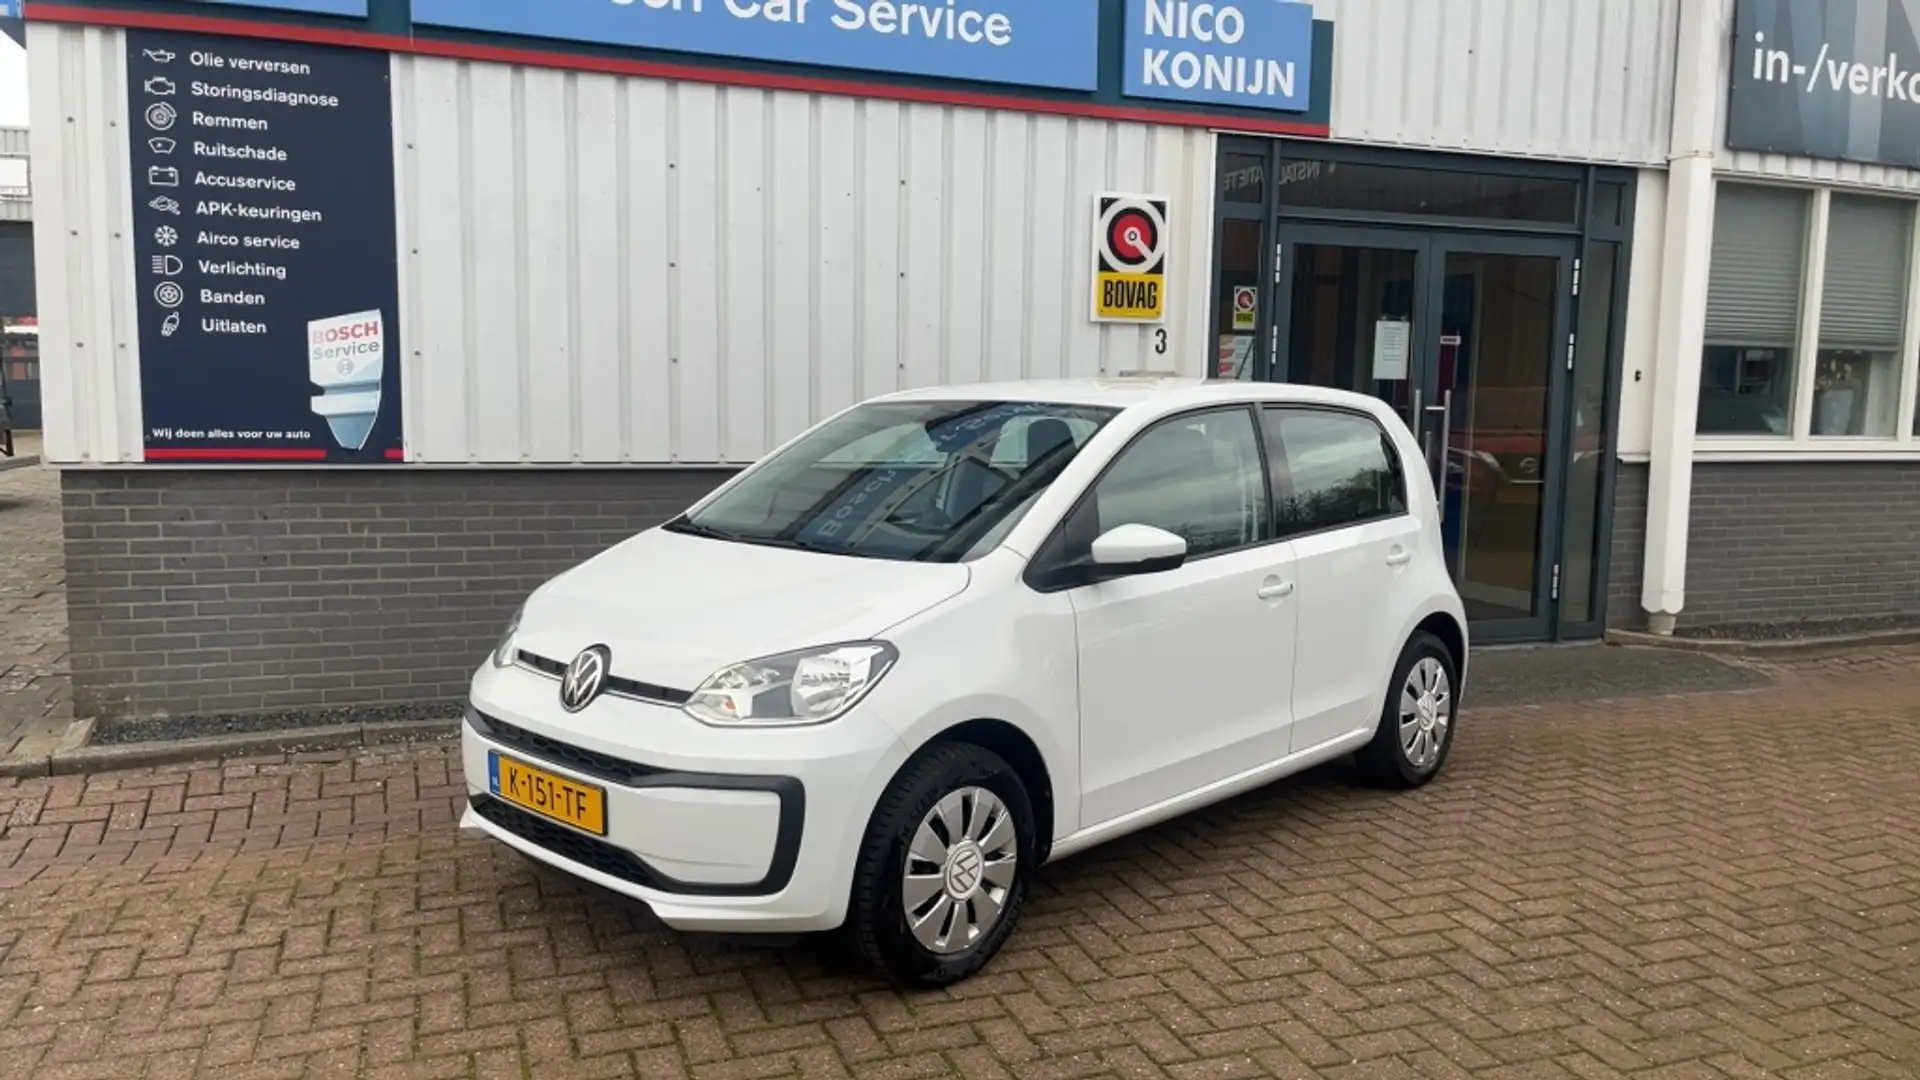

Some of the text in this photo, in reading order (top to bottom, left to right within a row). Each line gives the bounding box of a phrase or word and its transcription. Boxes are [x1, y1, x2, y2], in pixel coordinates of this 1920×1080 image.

[830, 0, 1012, 46] Service
[1144, 0, 1245, 44] NICO
[190, 51, 310, 75] Olie verversen
[1143, 48, 1295, 97] KONIJN
[191, 81, 339, 107] Storingsdiagnose
[192, 111, 268, 130] Remmen
[193, 141, 288, 161] Ruitschade
[195, 171, 296, 191] Accuservice
[196, 201, 322, 223] APK-keuringen
[197, 230, 300, 249] Airco service
[198, 259, 287, 280] Verlichting
[200, 288, 265, 305] Banden
[1103, 279, 1158, 310] BOVAG
[201, 318, 267, 334] Uitlaten
[313, 321, 379, 344] BOSCH
[313, 341, 380, 360] Service
[1154, 327, 1167, 355] 3
[152, 427, 311, 441] Wij doen alles voor uw auto
[509, 767, 587, 820] K-151-TF
